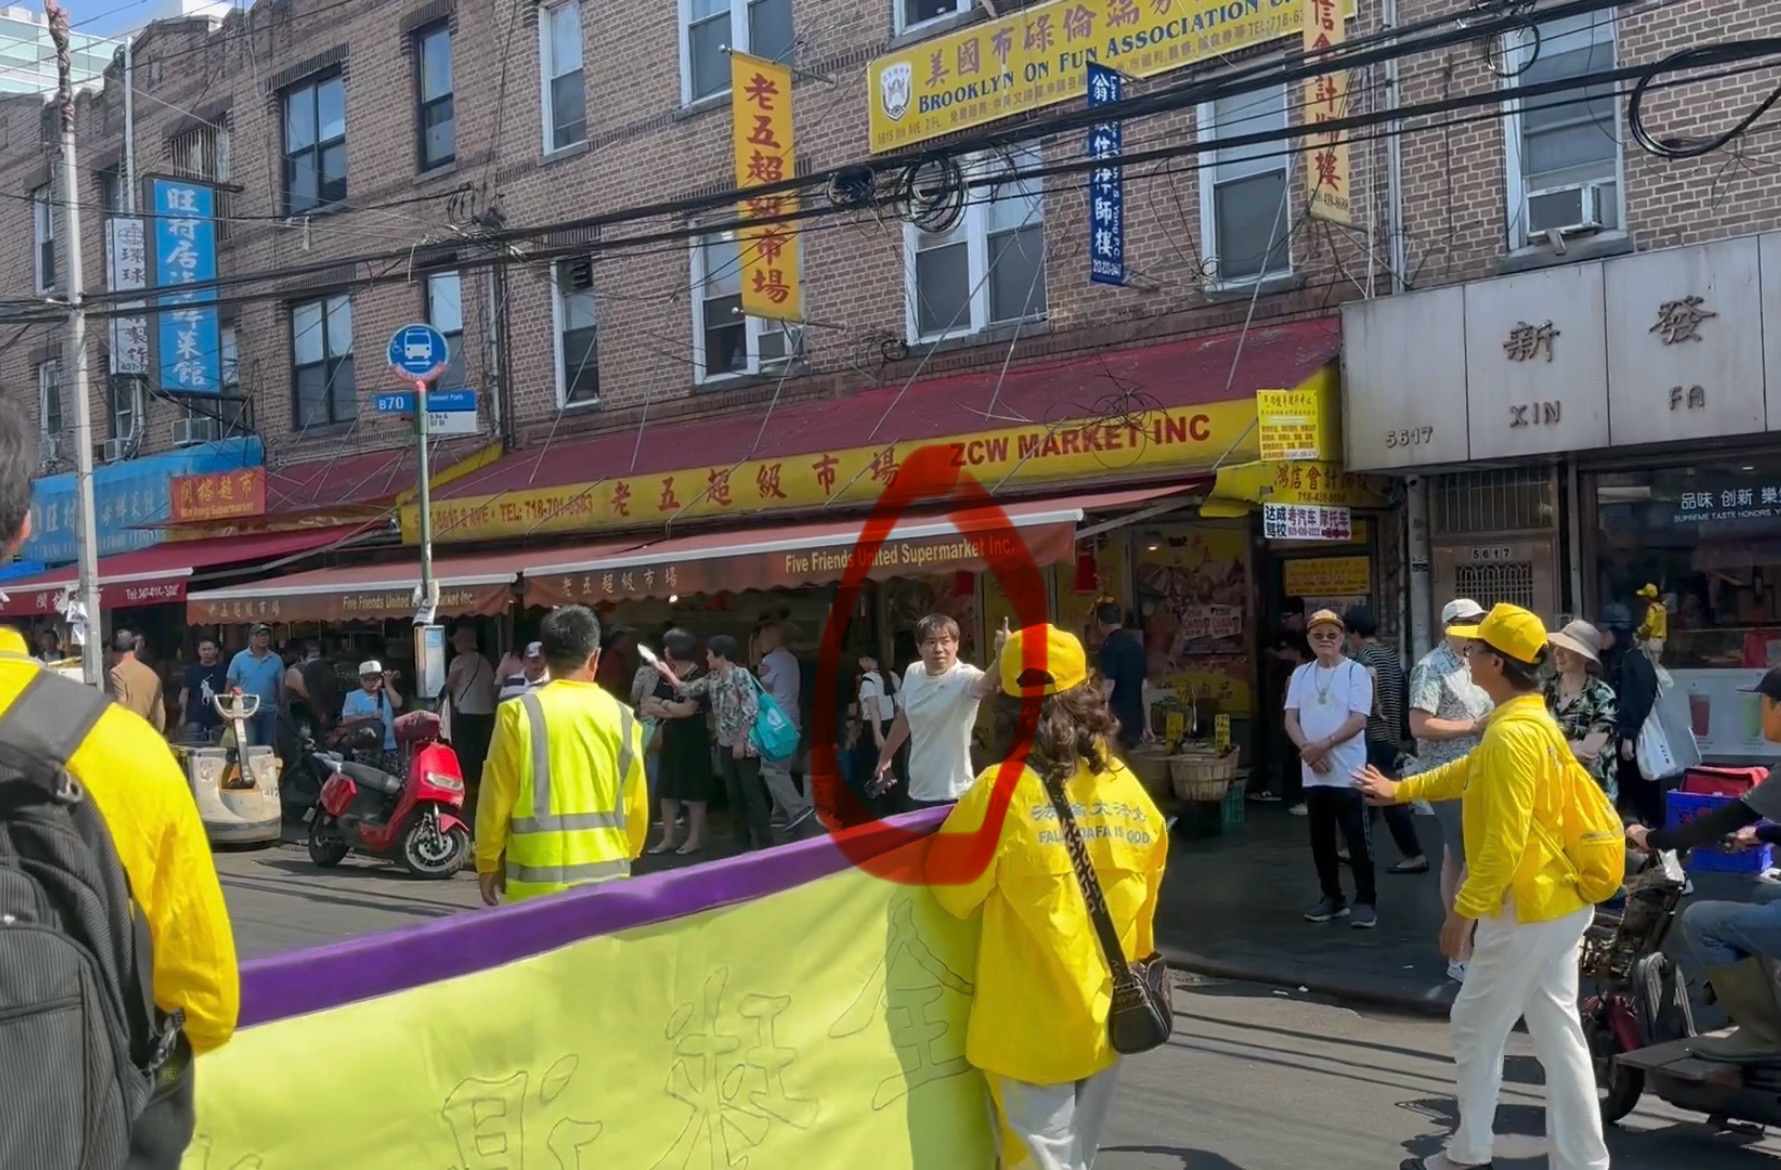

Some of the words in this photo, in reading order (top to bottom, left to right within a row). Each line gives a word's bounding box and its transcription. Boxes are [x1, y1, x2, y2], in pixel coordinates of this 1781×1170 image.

[919, 71, 1014, 114] BROOKLYN
[1024, 60, 1049, 83] ON
[1059, 46, 1097, 72] FUN
[1106, 0, 1258, 59] ASSOCIATION
[1503, 319, 1561, 363] 新
[1648, 295, 1719, 346] 發
[379, 396, 404, 410] B70
[1509, 400, 1561, 429] XIN
[1669, 385, 1706, 412] FA
[950, 437, 1009, 468] ZCW
[1018, 421, 1143, 460] MARKET
[1153, 414, 1212, 445] INC
[1385, 426, 1434, 448] 5617
[611, 446, 901, 517] 老五超級市場
[1681, 491, 1713, 509] 品味
[1721, 488, 1753, 507] 创新
[499, 502, 522, 523] TEL:
[785, 554, 808, 574] Five
[812, 550, 853, 571] Friends
[859, 545, 898, 566] United
[902, 538, 985, 567] Supermarket
[989, 534, 1015, 556] Inc.
[1473, 547, 1510, 560] 5617
[343, 596, 358, 611] Five
[358, 594, 384, 610] Friends
[386, 593, 409, 609] United
[1039, 829, 1066, 843] FALU
